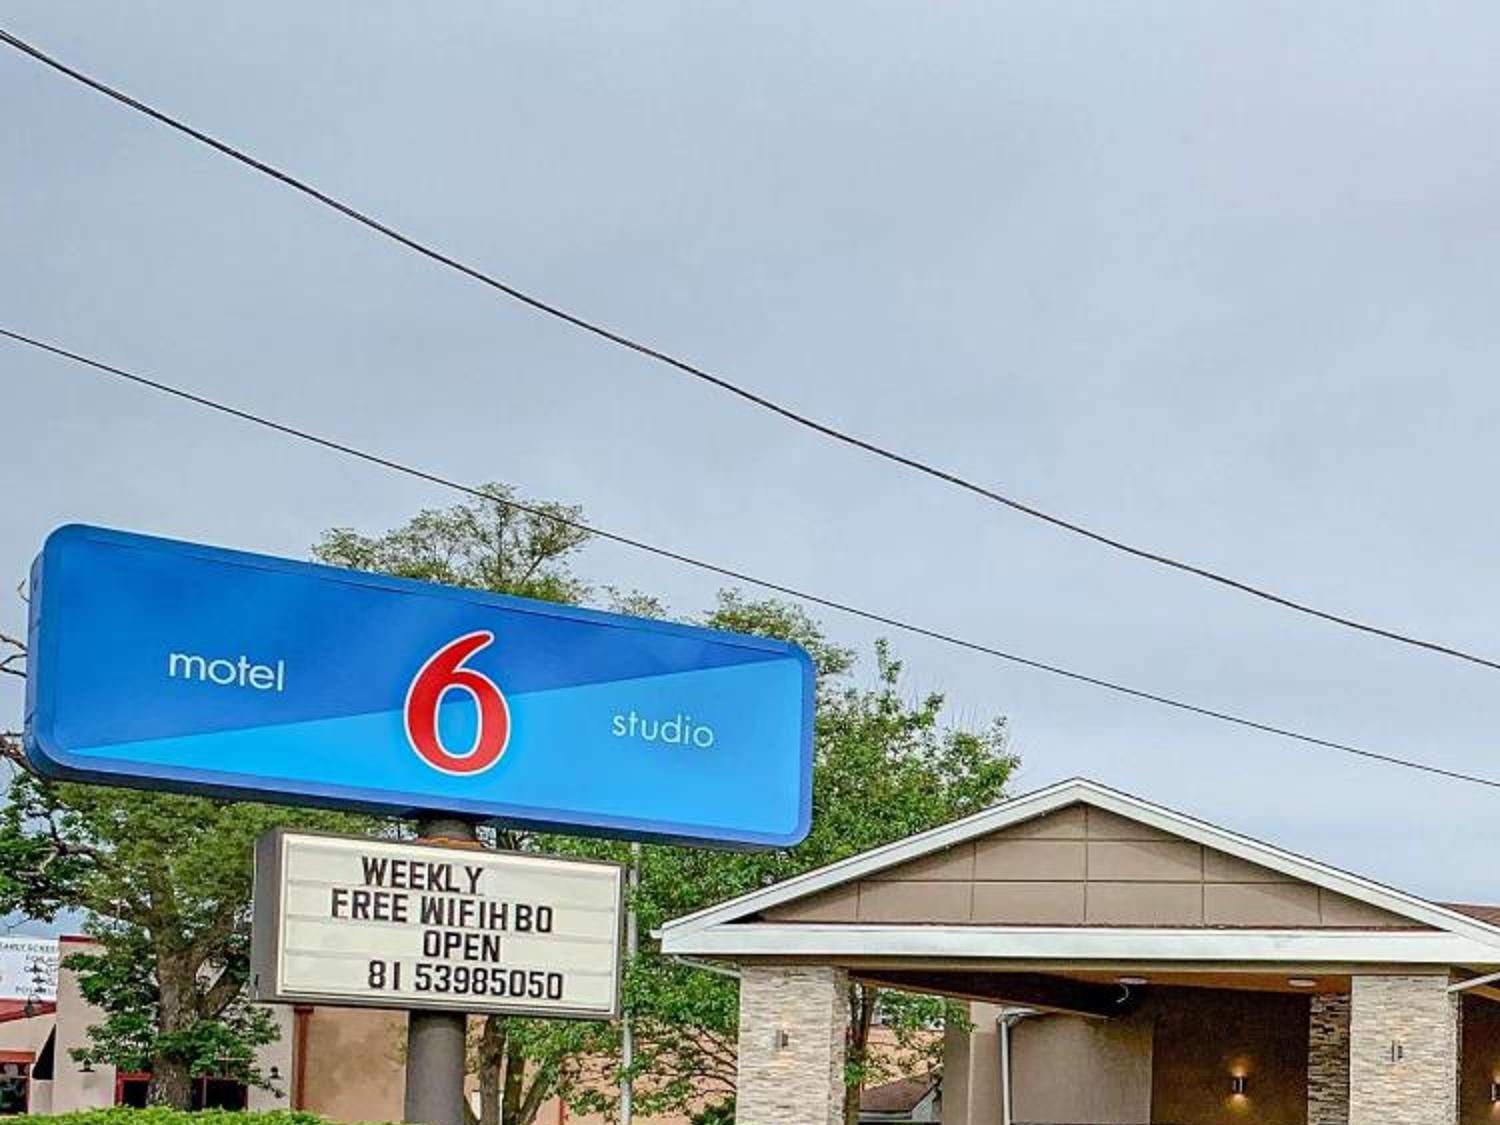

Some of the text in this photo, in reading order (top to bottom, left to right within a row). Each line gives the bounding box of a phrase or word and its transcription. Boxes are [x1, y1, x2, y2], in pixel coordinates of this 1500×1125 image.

[169, 630, 714, 776] motel 6 studio
[361, 856, 484, 894] WEEKLY
[331, 888, 408, 922] FREE
[423, 930, 501, 962] OPEN
